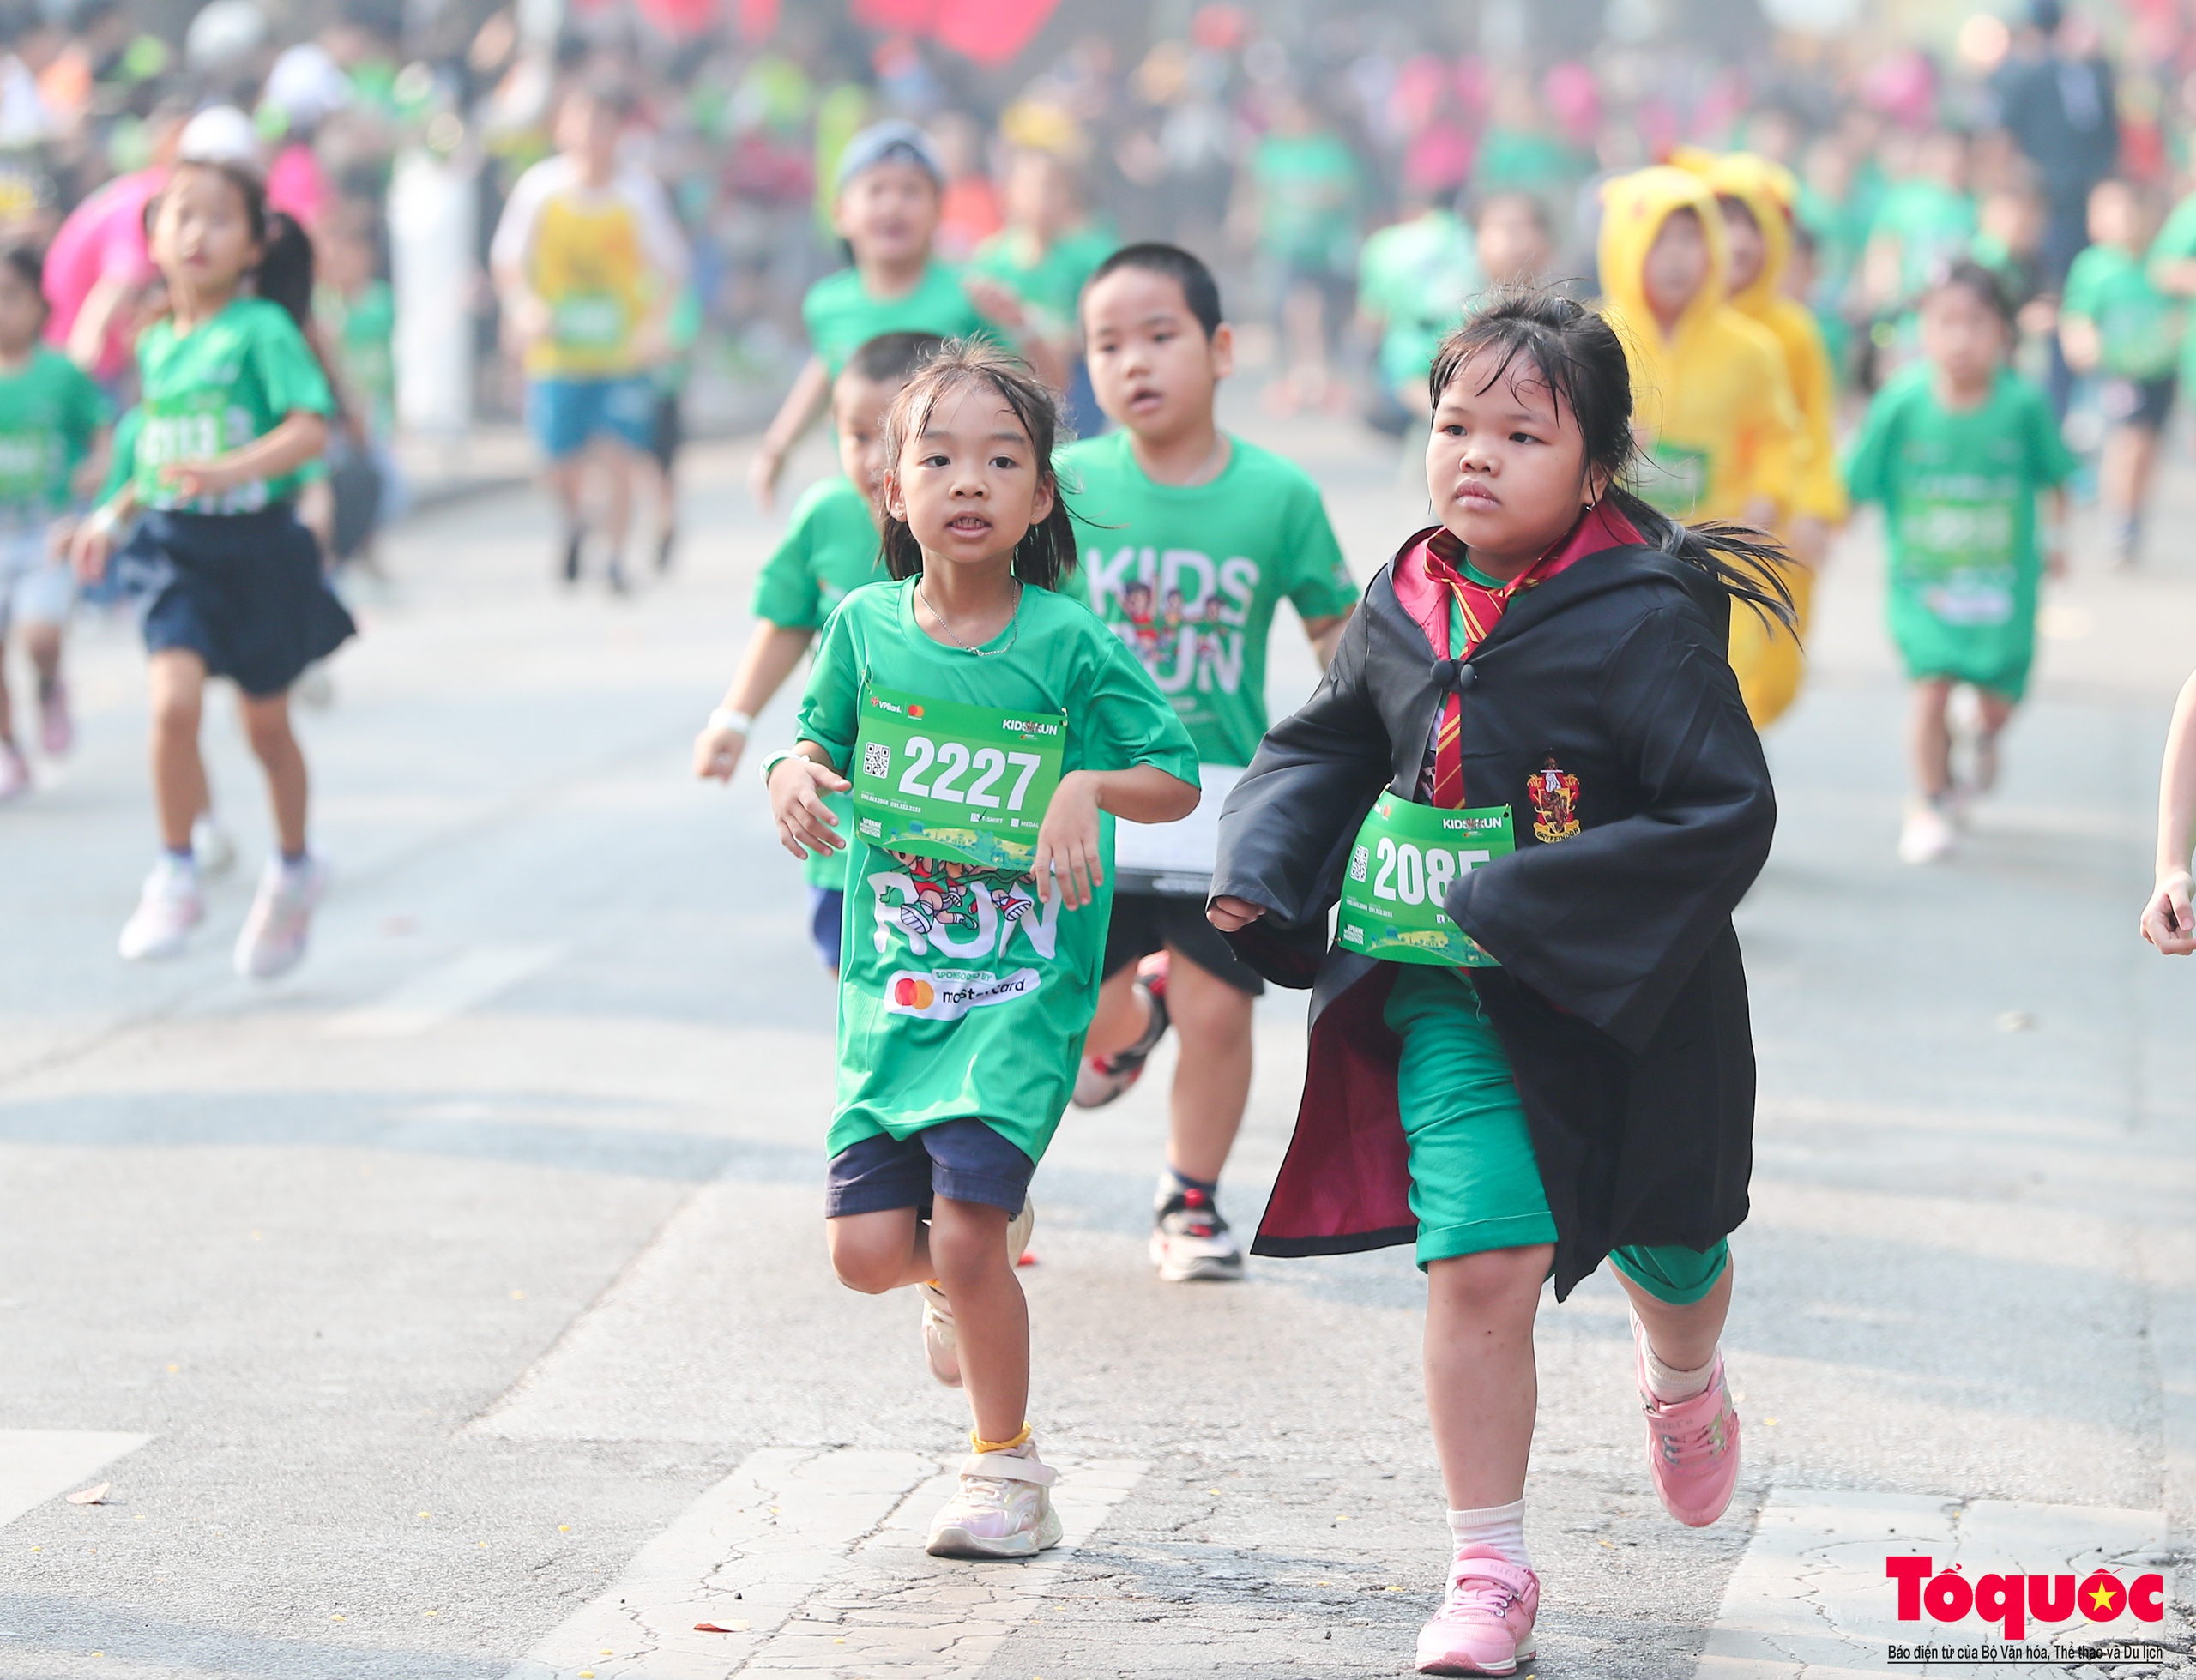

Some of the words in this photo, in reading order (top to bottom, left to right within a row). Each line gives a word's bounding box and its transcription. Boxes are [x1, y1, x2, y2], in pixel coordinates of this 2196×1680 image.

[1086, 546, 1260, 627] KIDS
[898, 736, 1041, 810] 2227
[1536, 828, 1580, 842] GRYFFINDOR
[867, 871, 1062, 960] RUN
[980, 972, 992, 982] BY
